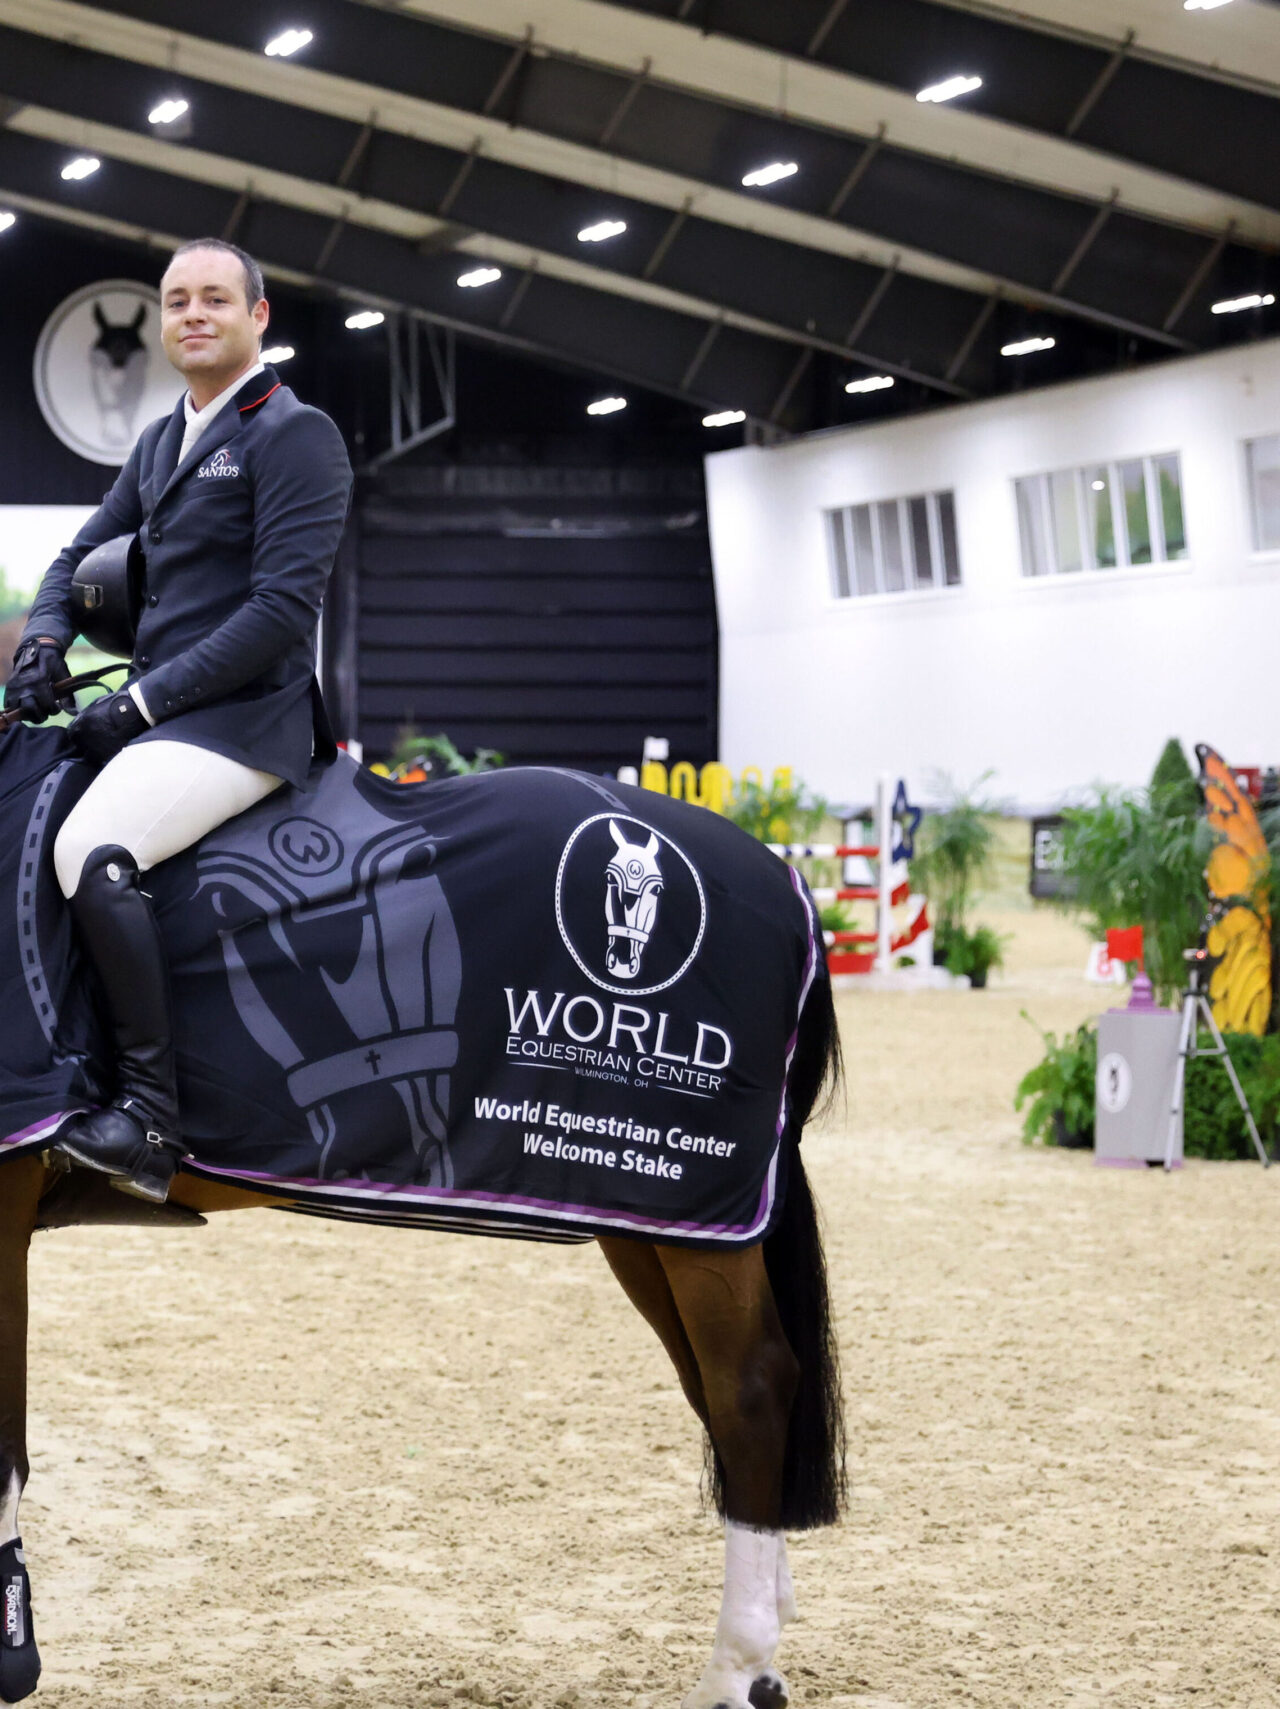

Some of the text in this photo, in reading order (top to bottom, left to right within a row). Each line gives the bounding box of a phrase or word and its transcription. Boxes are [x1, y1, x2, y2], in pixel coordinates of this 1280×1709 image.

[198, 465, 240, 479] SANTOS
[504, 987, 733, 1070] WORLD
[505, 1036, 722, 1091] EQUESTRIAN CENTER
[633, 1078, 649, 1089] OH
[474, 1096, 737, 1158] World Equestrian Center
[523, 1132, 683, 1180] Welcome Stake
